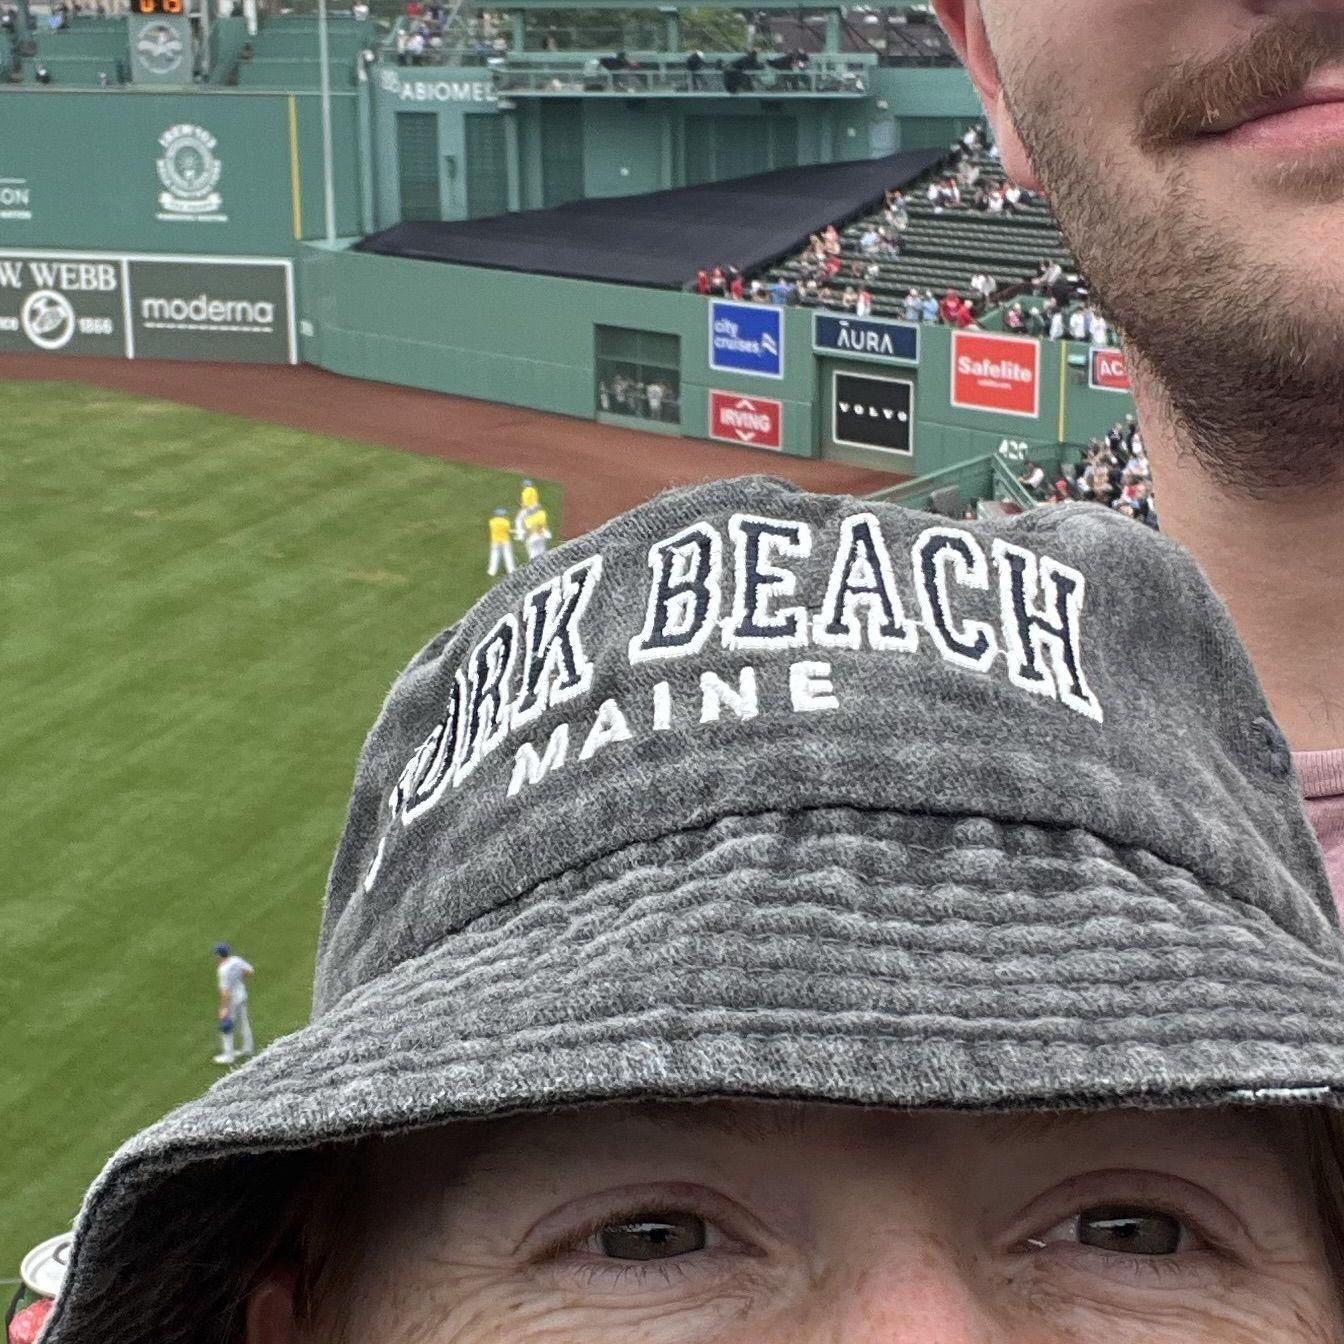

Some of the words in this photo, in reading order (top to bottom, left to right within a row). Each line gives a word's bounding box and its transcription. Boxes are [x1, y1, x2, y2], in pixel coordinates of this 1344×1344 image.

[29, 261, 118, 292] WEBB
[141, 294, 275, 325] moderna
[713, 317, 739, 337] city
[713, 335, 761, 355] cruises
[957, 355, 1034, 384] Safelite
[1100, 359, 1124, 377] AC
[719, 406, 771, 434] IRVING
[837, 400, 908, 422] VOLVO
[363, 553, 603, 894] ORK
[628, 511, 1103, 724] BEACH
[506, 660, 841, 797] MAINE
